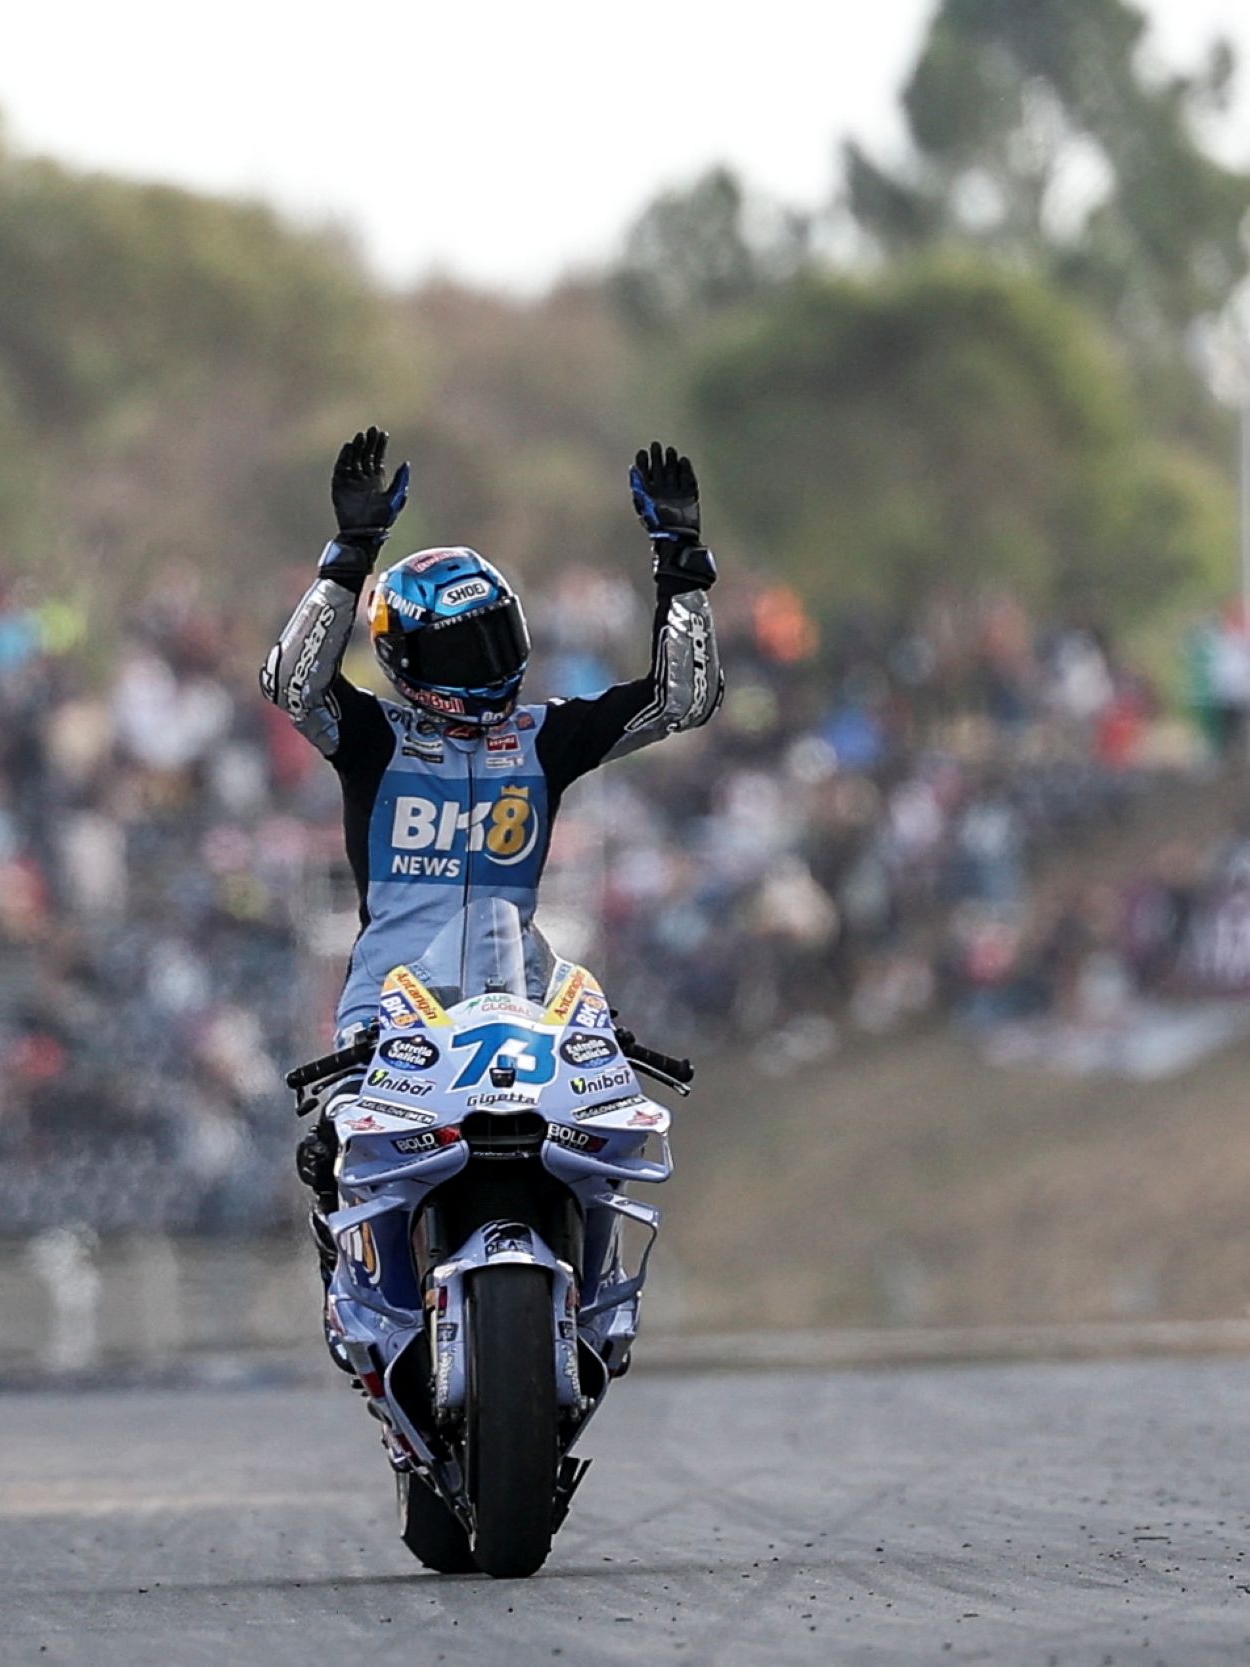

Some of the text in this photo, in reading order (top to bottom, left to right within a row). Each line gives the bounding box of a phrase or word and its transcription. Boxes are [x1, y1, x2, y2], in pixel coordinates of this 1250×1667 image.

[287, 603, 336, 721] pinestars
[686, 611, 710, 718] alpines
[391, 796, 530, 855] BK8
[391, 853, 461, 878] NEWS
[451, 1023, 556, 1090] 73
[367, 1068, 434, 1097] Unibat
[570, 1069, 631, 1095] Unibat
[396, 1133, 435, 1151] BOLD
[548, 1123, 589, 1145] BOLD
